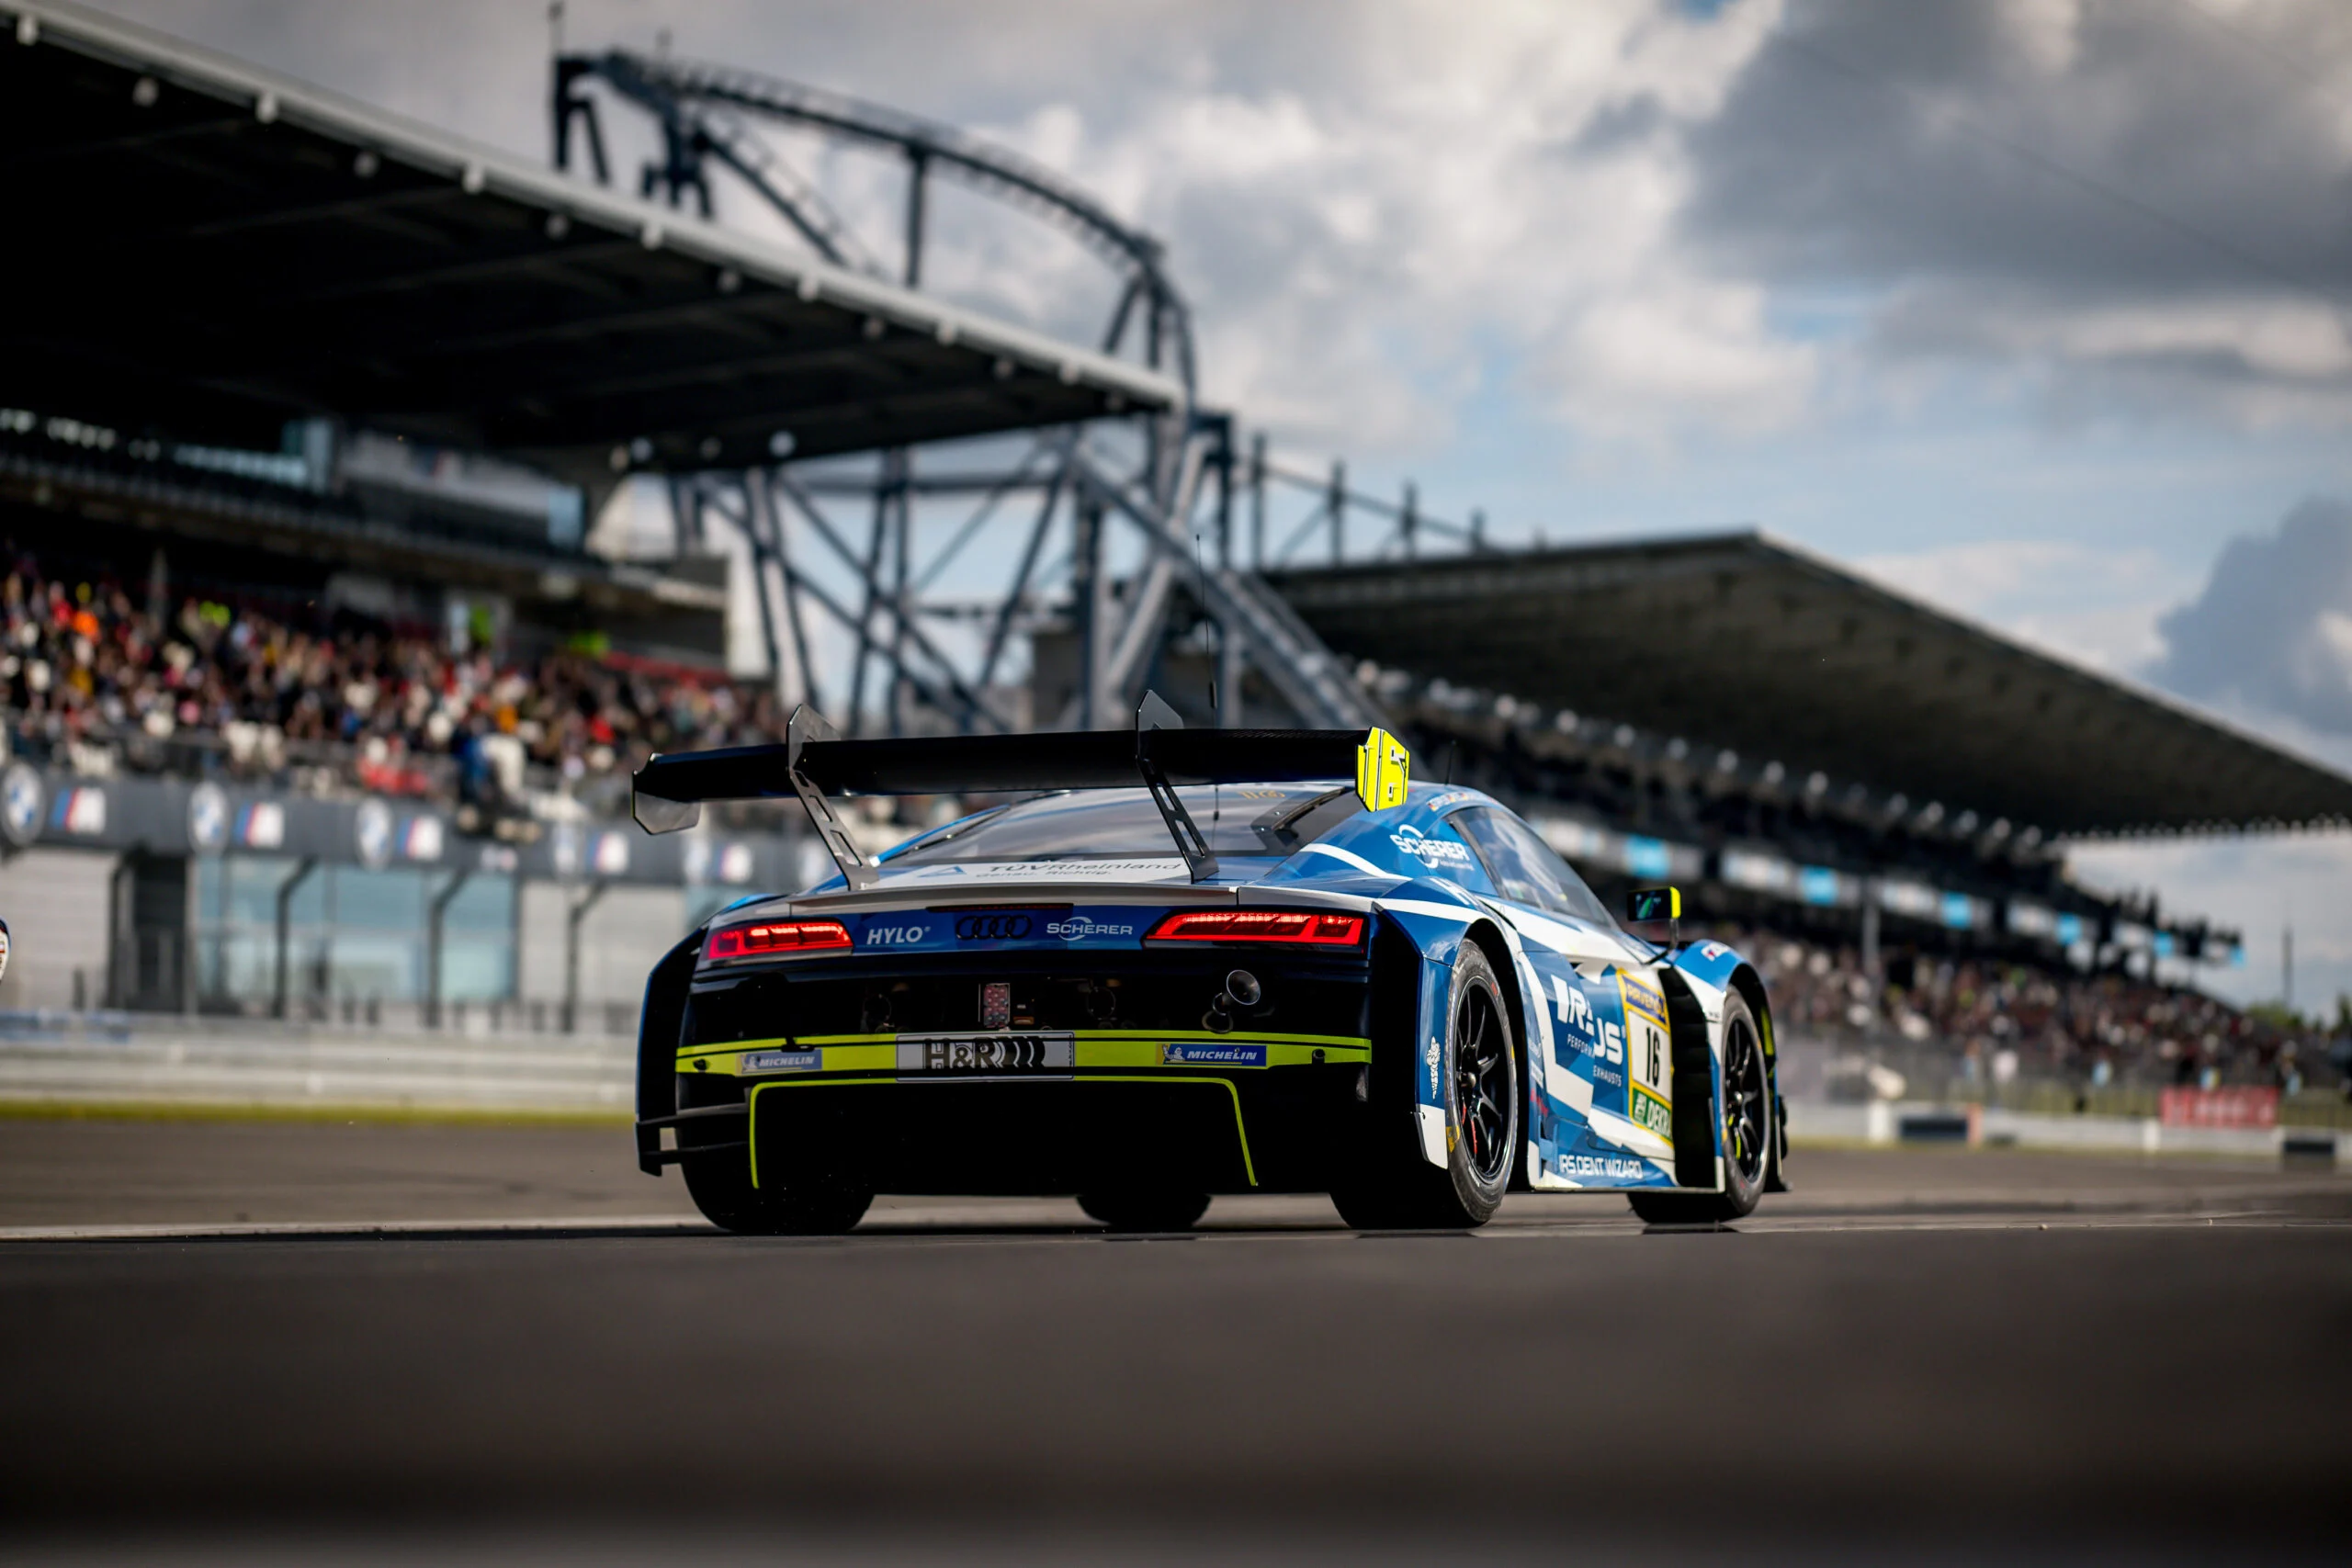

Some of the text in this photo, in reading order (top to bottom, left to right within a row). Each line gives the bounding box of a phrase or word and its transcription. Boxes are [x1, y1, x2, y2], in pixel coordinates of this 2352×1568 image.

[1389, 831, 1470, 862] SCHERER
[1046, 921, 1133, 936] SCHERER
[759, 1056, 816, 1067] MICHELIN
[1186, 1051, 1258, 1061] MICHELIN
[1645, 1026, 1660, 1088] 16
[1592, 1065, 1623, 1087] EXHAUSTS
[1576, 1156, 1604, 1177] DENT
[1604, 1157, 1644, 1179] WIZARD
